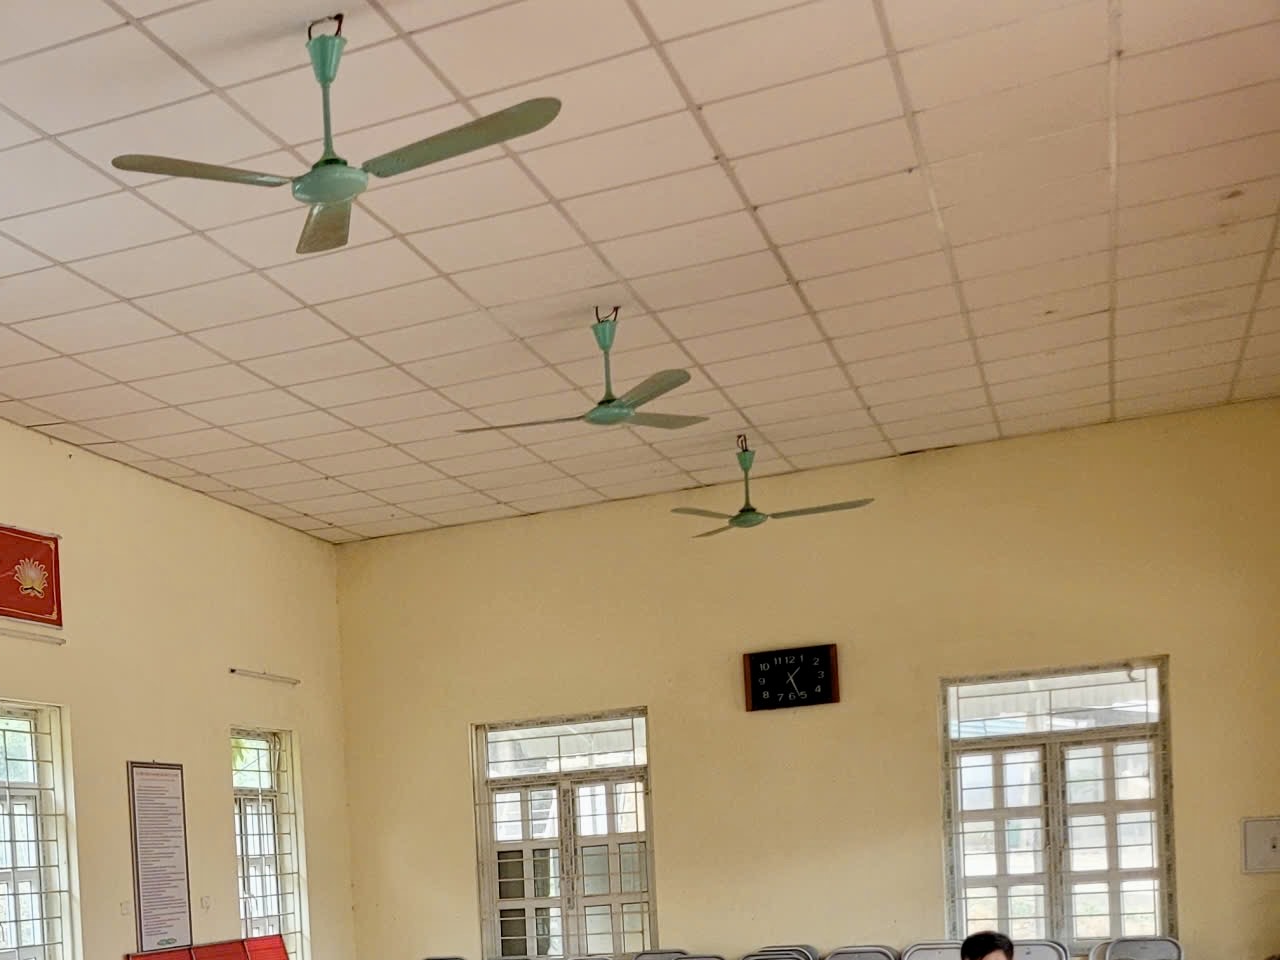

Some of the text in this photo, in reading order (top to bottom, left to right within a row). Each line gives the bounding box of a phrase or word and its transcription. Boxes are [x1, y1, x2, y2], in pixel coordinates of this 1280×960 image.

[773, 656, 782, 665] 11
[784, 655, 796, 664] 12
[799, 653, 804, 663] 1
[812, 657, 820, 666] 2
[759, 662, 770, 671] 10
[817, 670, 825, 679] 3
[758, 677, 766, 686] 9
[814, 684, 821, 693] 4
[762, 690, 770, 699] 8
[777, 692, 784, 702] 7
[788, 692, 796, 701] 6
[799, 690, 808, 699] 5
